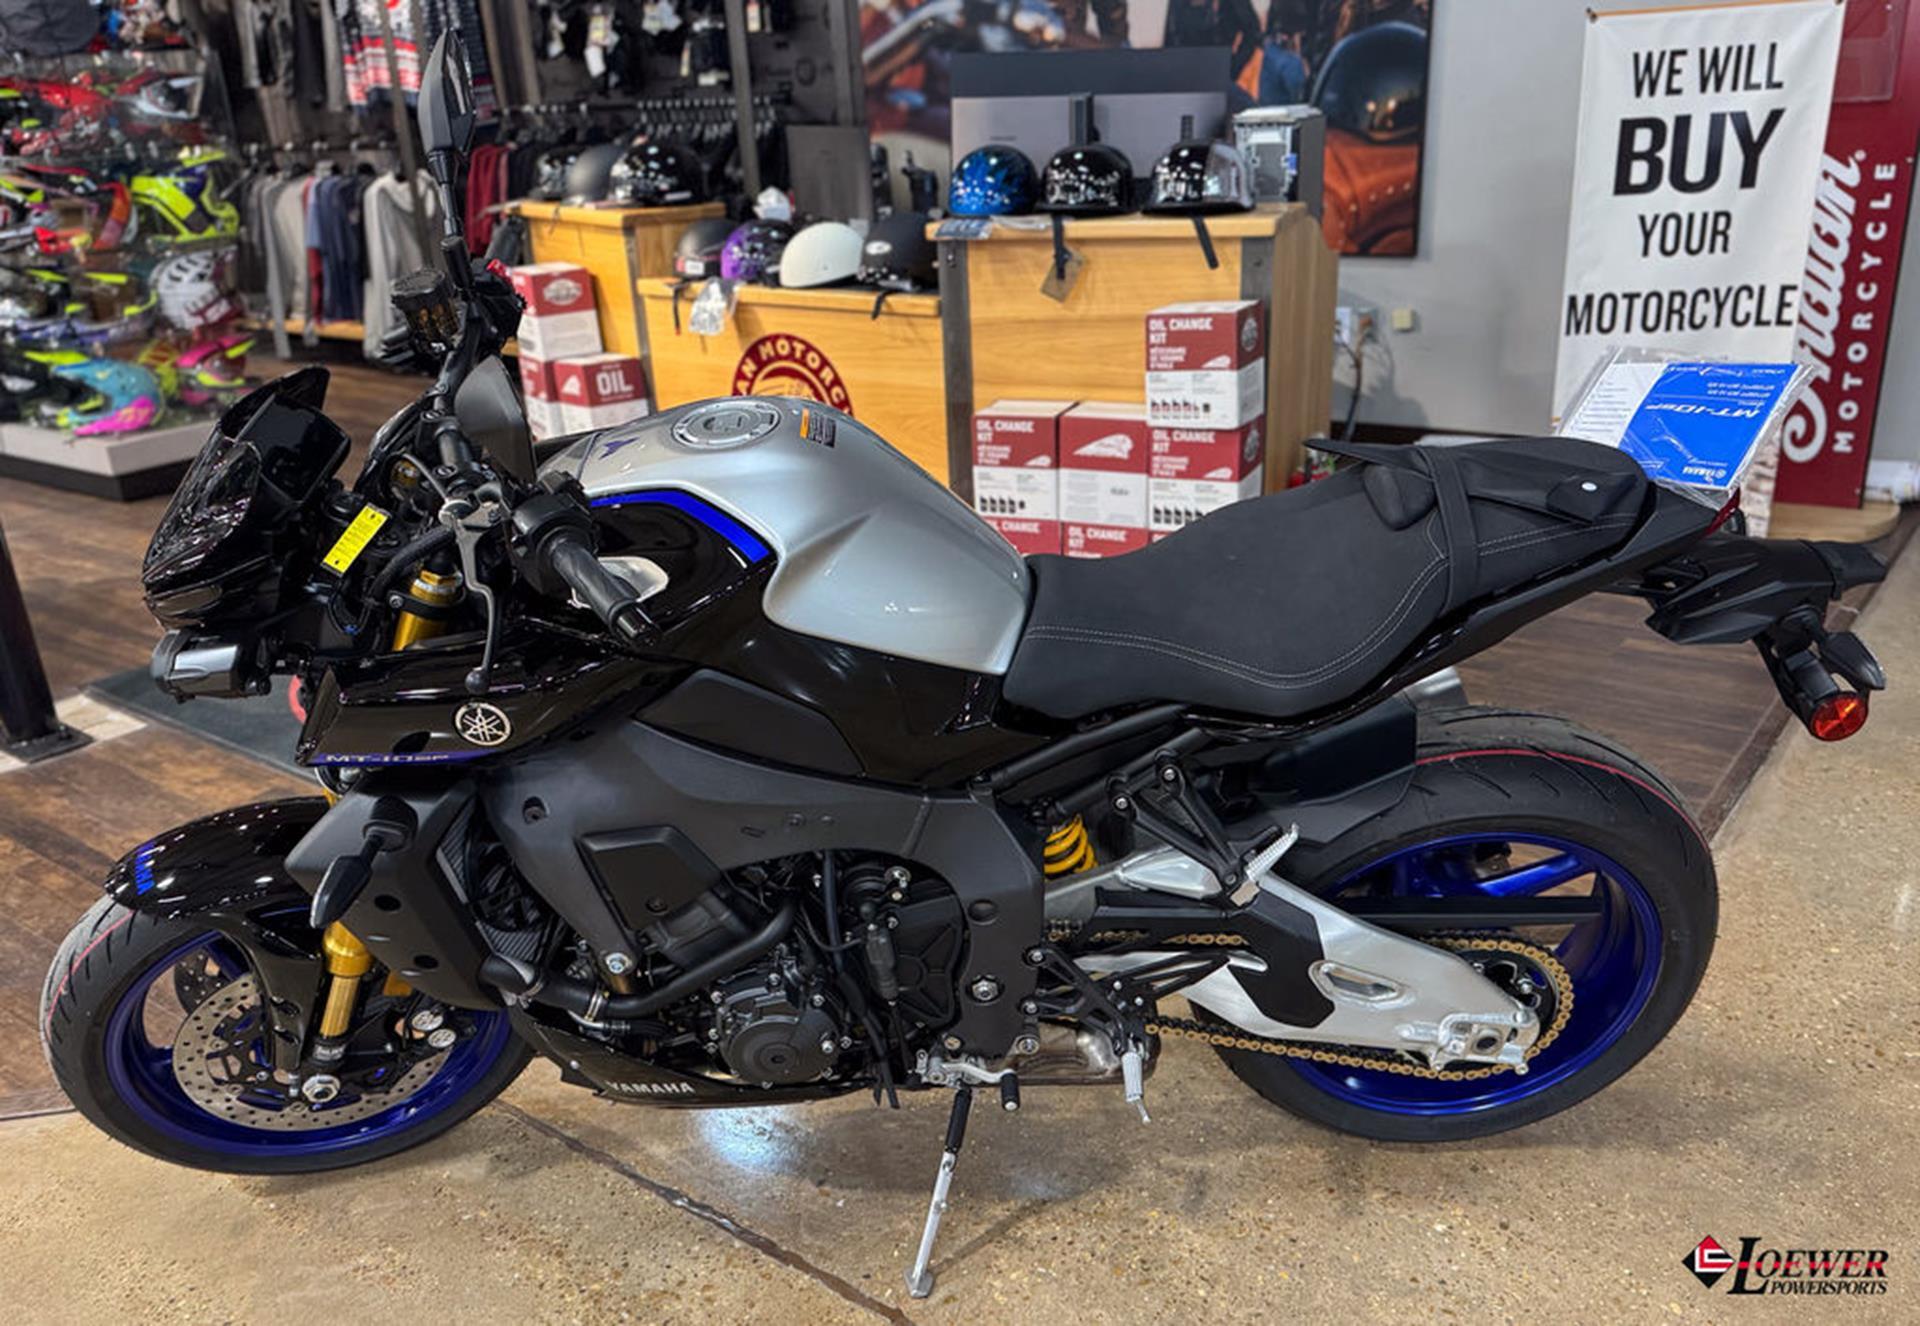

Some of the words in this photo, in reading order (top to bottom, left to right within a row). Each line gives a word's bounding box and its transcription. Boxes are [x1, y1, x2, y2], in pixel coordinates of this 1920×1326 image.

[1633, 49, 1688, 98] WE
[1699, 42, 1784, 94] WILL
[1613, 108, 1787, 196] BUY
[1638, 210, 1733, 258] YOUR
[1149, 318, 1167, 331] OIL
[1168, 317, 1214, 331] CHANGE
[1564, 284, 1799, 337] MOTORCYCLE
[1834, 163, 1897, 454] MOTORCYCLE
[595, 370, 634, 396] OIL
[976, 419, 993, 432] OIL
[604, 1080, 697, 1094] YAMAHA
